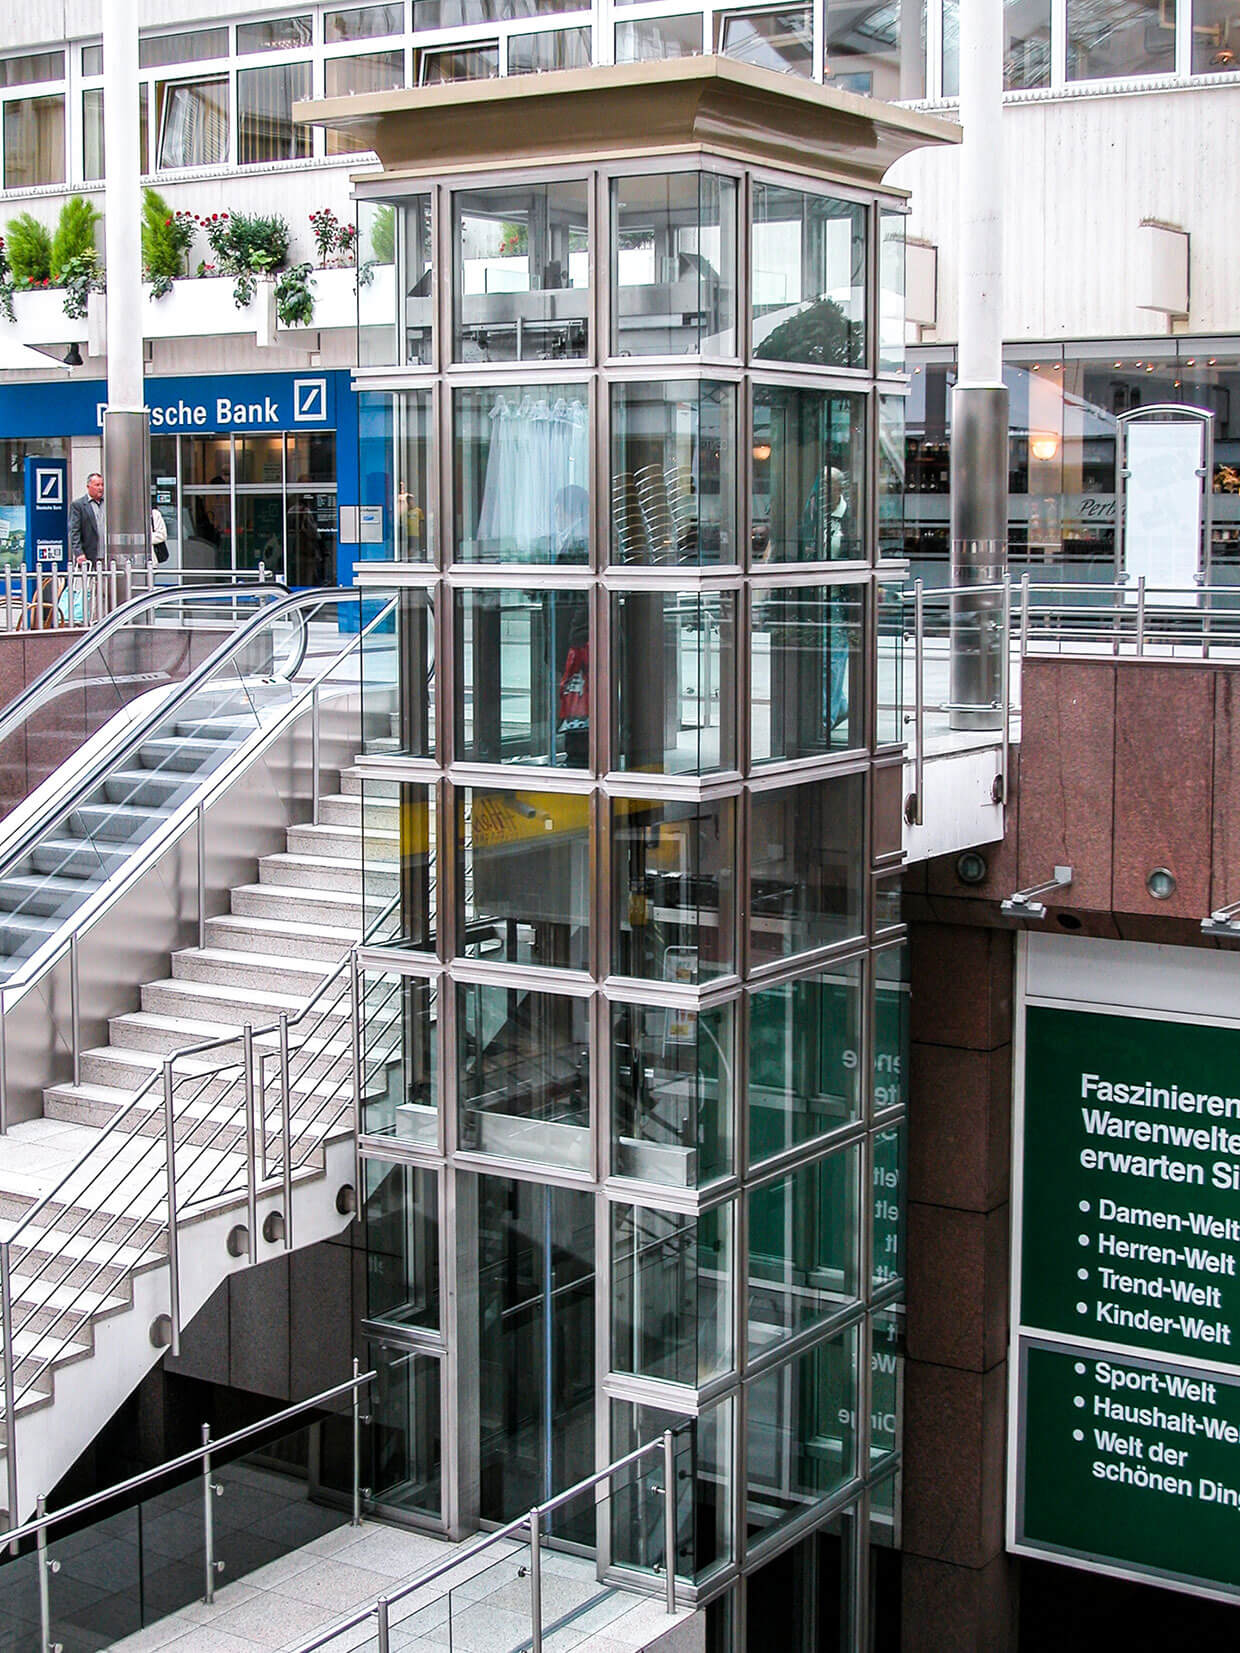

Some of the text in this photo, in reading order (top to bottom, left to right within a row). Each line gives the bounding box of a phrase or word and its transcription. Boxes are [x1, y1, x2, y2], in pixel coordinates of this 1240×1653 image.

[96, 396, 279, 428] Dsche Bank
[1081, 1073, 1240, 1119] Faszinieren
[1081, 1107, 1240, 1156] Warenwelte
[1080, 1147, 1240, 1191] erwarten Si
[1099, 1198, 1240, 1242] Damen-Welt
[1098, 1232, 1236, 1276] Herren-Welt
[1098, 1266, 1222, 1309] Trend-Welt
[1096, 1300, 1232, 1346] Kinder-Welt
[1095, 1361, 1217, 1405] Sport-Welt
[1093, 1428, 1189, 1467] Welt der
[1091, 1460, 1240, 1512] schönen Din
